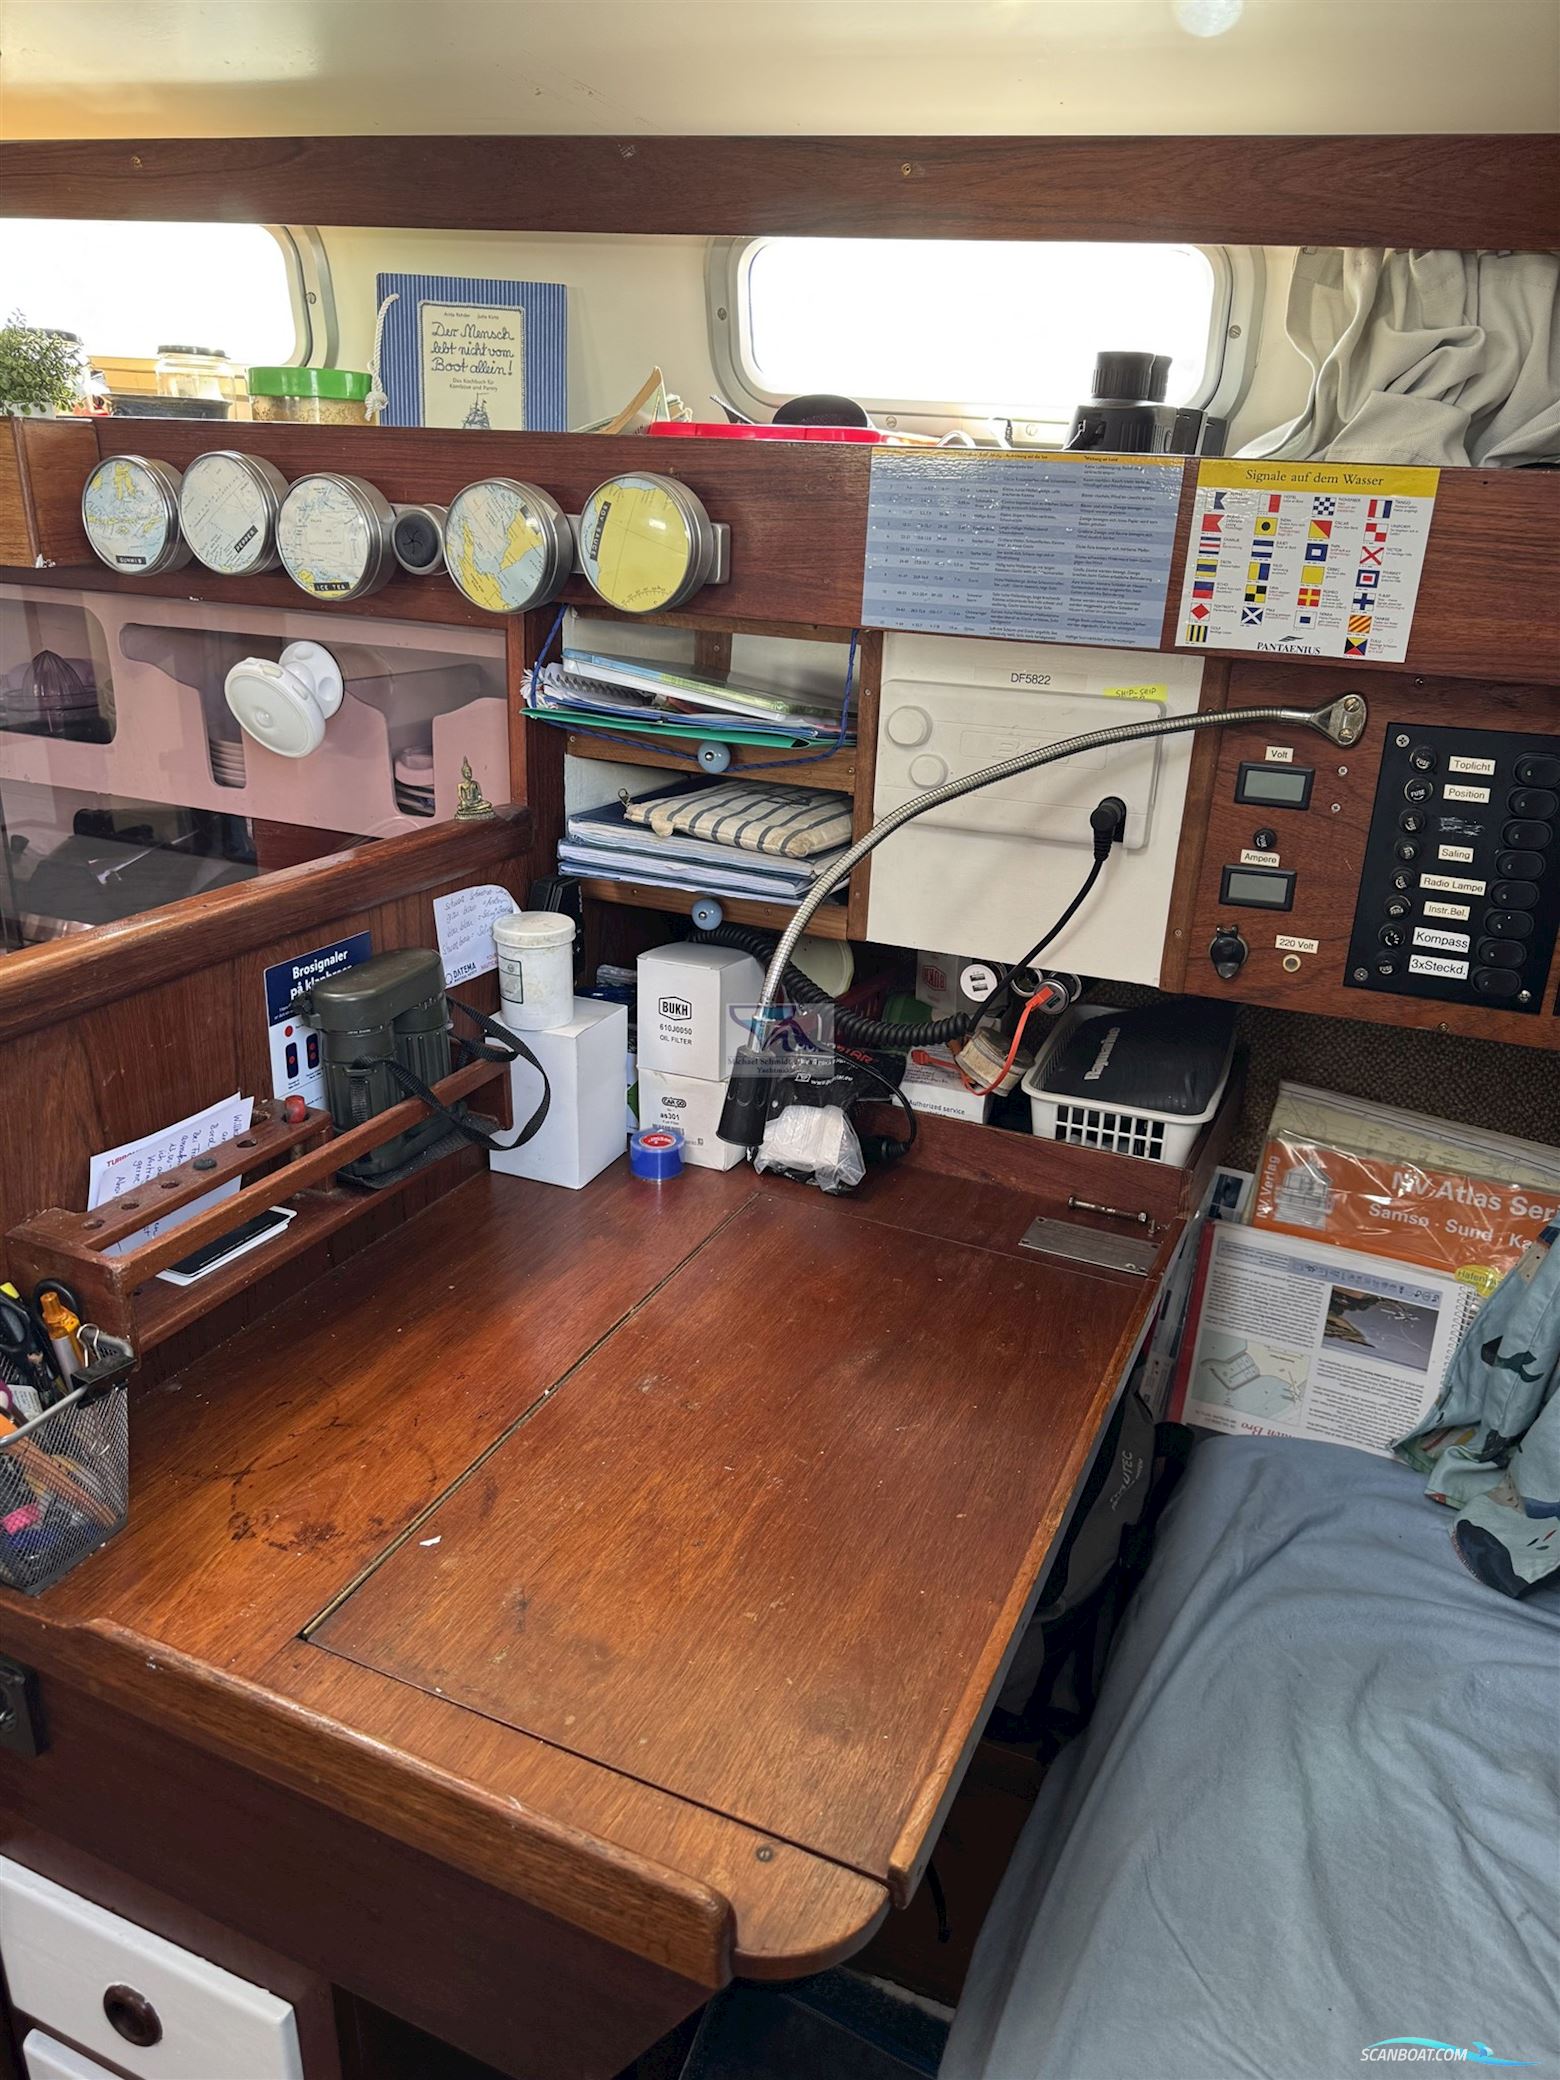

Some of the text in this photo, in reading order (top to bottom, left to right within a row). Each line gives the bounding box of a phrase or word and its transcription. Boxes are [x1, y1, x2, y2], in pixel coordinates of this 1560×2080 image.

[431, 321, 515, 341] Der Mensch
[431, 340, 515, 358] lebt nicht vom
[431, 356, 468, 373] Boot
[1246, 469, 1384, 487] Signale auf dem Wasser
[1256, 641, 1321, 656] PANTAENIUS
[1010, 672, 1052, 686] DF5822
[1271, 749, 1288, 760] Volt
[1453, 760, 1491, 773] Toplicht
[1448, 788, 1486, 801] Position
[1244, 852, 1277, 866] Ampere
[1441, 847, 1471, 861] Saling
[1423, 877, 1484, 894] Radio Lampe
[1428, 904, 1467, 918] Instr.Bel.
[1278, 938, 1315, 951] 220 Volt
[1415, 930, 1468, 950] Kompass
[292, 950, 349, 980] Brosignaler
[453, 962, 477, 978] DATEMA
[1411, 958, 1466, 976] 3xSteckd.
[290, 982, 304, 1000] på
[662, 1001, 688, 1016] BUKH
[659, 1023, 692, 1035] 610J0050
[659, 1034, 692, 1045] OIL FILTER
[943, 1104, 965, 1116] service
[1260, 1155, 1281, 1197] Verlag
[1434, 1175, 1502, 1212] Atlas
[1368, 1203, 1430, 1227] Samsø
[1445, 1219, 1493, 1243] Sund
